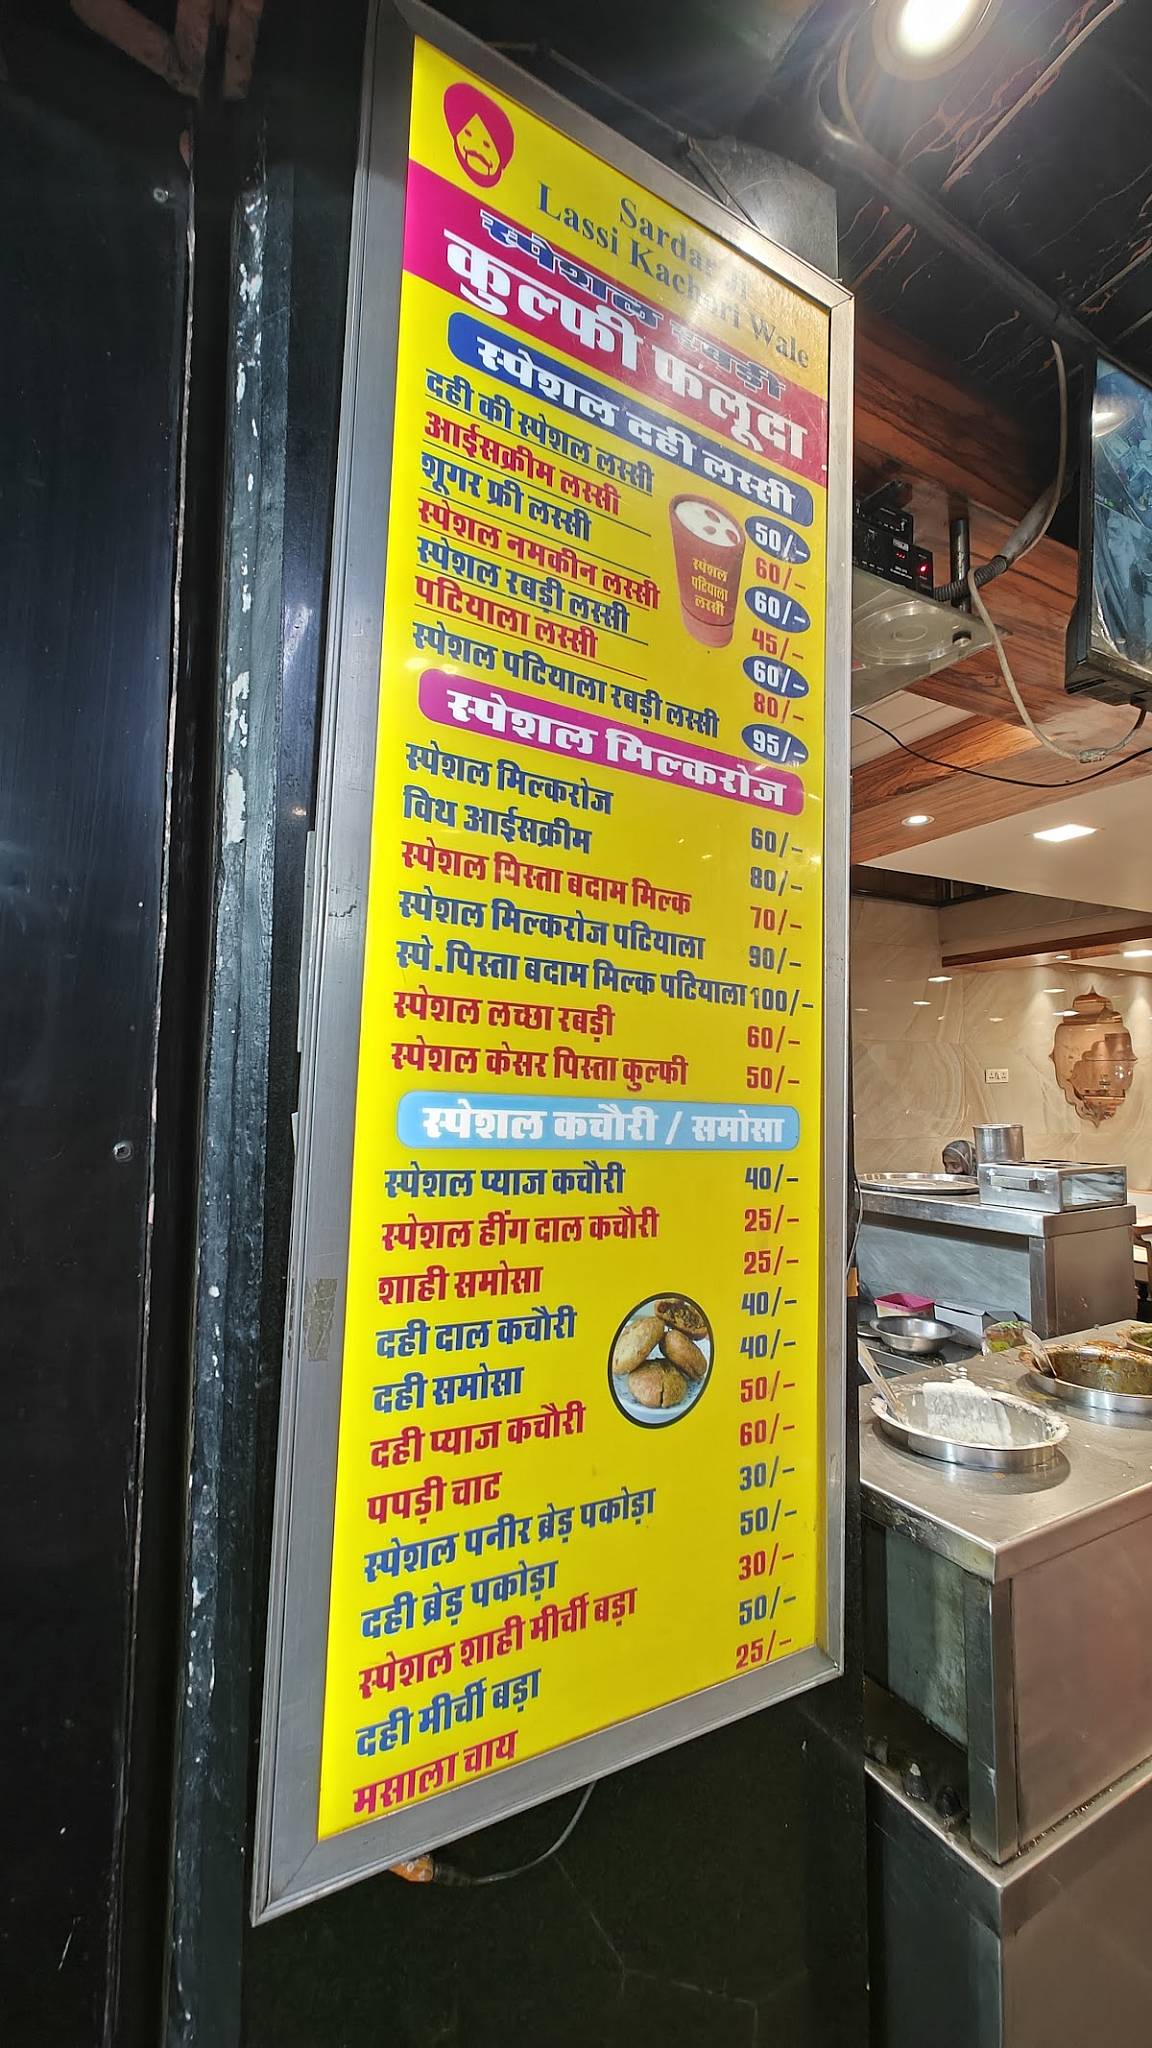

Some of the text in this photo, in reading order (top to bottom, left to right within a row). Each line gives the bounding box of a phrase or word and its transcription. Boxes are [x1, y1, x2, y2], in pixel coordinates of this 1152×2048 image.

[480, 209, 664, 330] स्पेशल
[538, 179, 618, 256] Lassi
[750, 310, 810, 369] Wale
[444, 228, 809, 461] कुल्फी फलूदा
[426, 368, 655, 493] दही की स्पेशल लस्सी
[476, 336, 797, 515] स्पेशल दही लस्सी
[424, 411, 621, 516] आईसक्रीम लस्सी
[420, 452, 592, 541] शूगर फ्री लस्सी
[418, 498, 661, 610] स्पेशल नमकीन लस्सी
[754, 522, 808, 558] 50/-
[417, 536, 630, 634] स्पेशल रबड़ी लस्सी
[755, 556, 806, 591] 60/-
[415, 575, 598, 659] पटियाला लस्सी
[754, 591, 806, 625] 60/-
[751, 628, 804, 661] 45/-
[413, 621, 720, 739] स्पेशल पटियाला रबड़ी लस्सी
[753, 659, 805, 693] 60/-
[753, 692, 805, 723] 80/-
[446, 689, 788, 807] स्पेशल मिल्करोज
[753, 729, 806, 762] 95/-
[405, 740, 614, 816] स्पेशल मिल्करोज
[403, 785, 592, 855] विथ आईसक्रीम
[751, 827, 803, 858] 60/-
[401, 837, 693, 915] स्पेशल पिस्ता बदाम मिल्क
[750, 866, 803, 897] 80/-
[399, 885, 706, 960] स्पेशल मिल्करोज पटियाला
[750, 905, 802, 935] 70/-
[446, 939, 520, 980] पिस्ता
[524, 957, 589, 988] बदाम
[593, 959, 656, 995] मिल्क
[660, 969, 748, 1006] पटियाला
[748, 945, 802, 974] 90/-
[393, 984, 616, 1043] स्पेशल लच्छा रबड़ी
[750, 987, 814, 1017] 100/-
[747, 1025, 801, 1053] 60/-
[391, 1035, 688, 1092] स्पेशल केसर पिस्ता कुल्फी
[746, 1065, 800, 1094] 50/-
[421, 1098, 785, 1145] स्पेशल कचौरी / समोसा
[384, 1160, 625, 1198] स्पेशल प्याज कचौरी
[744, 1163, 799, 1193] 40/-
[382, 1205, 660, 1251] स्पेशल हींग दाल कचौरी
[744, 1204, 799, 1234] 25/-
[378, 1260, 544, 1305] शाही समोसा
[743, 1246, 799, 1276] 25/-
[741, 1286, 797, 1317] 40/-
[375, 1304, 578, 1359] दही दाल कचौरी
[739, 1329, 796, 1360] 40/-
[372, 1362, 525, 1414] दही समोसा
[740, 1370, 796, 1403] 50/-
[370, 1400, 587, 1469] दही प्याज कचौरी
[739, 1412, 796, 1447] 60/-
[739, 1455, 795, 1491] 30/-
[367, 1471, 502, 1525] पपड़ी चाट
[739, 1499, 797, 1536] 50/-
[363, 1536, 459, 1583] स्पेशल
[465, 1513, 532, 1556] पनीर
[580, 1486, 656, 1526] पकोड़ा
[738, 1542, 795, 1581] 30/-
[360, 1590, 417, 1640] दही
[471, 1559, 559, 1607] पकोड़ा
[739, 1586, 797, 1626] 50/-
[358, 1587, 637, 1700] स्पेशल शाही मीर्ची बड़ा
[735, 1630, 792, 1670] 25/-
[355, 1668, 542, 1757] दही मीर्ची बड़ा
[353, 1730, 519, 1815] मसाला चाय
